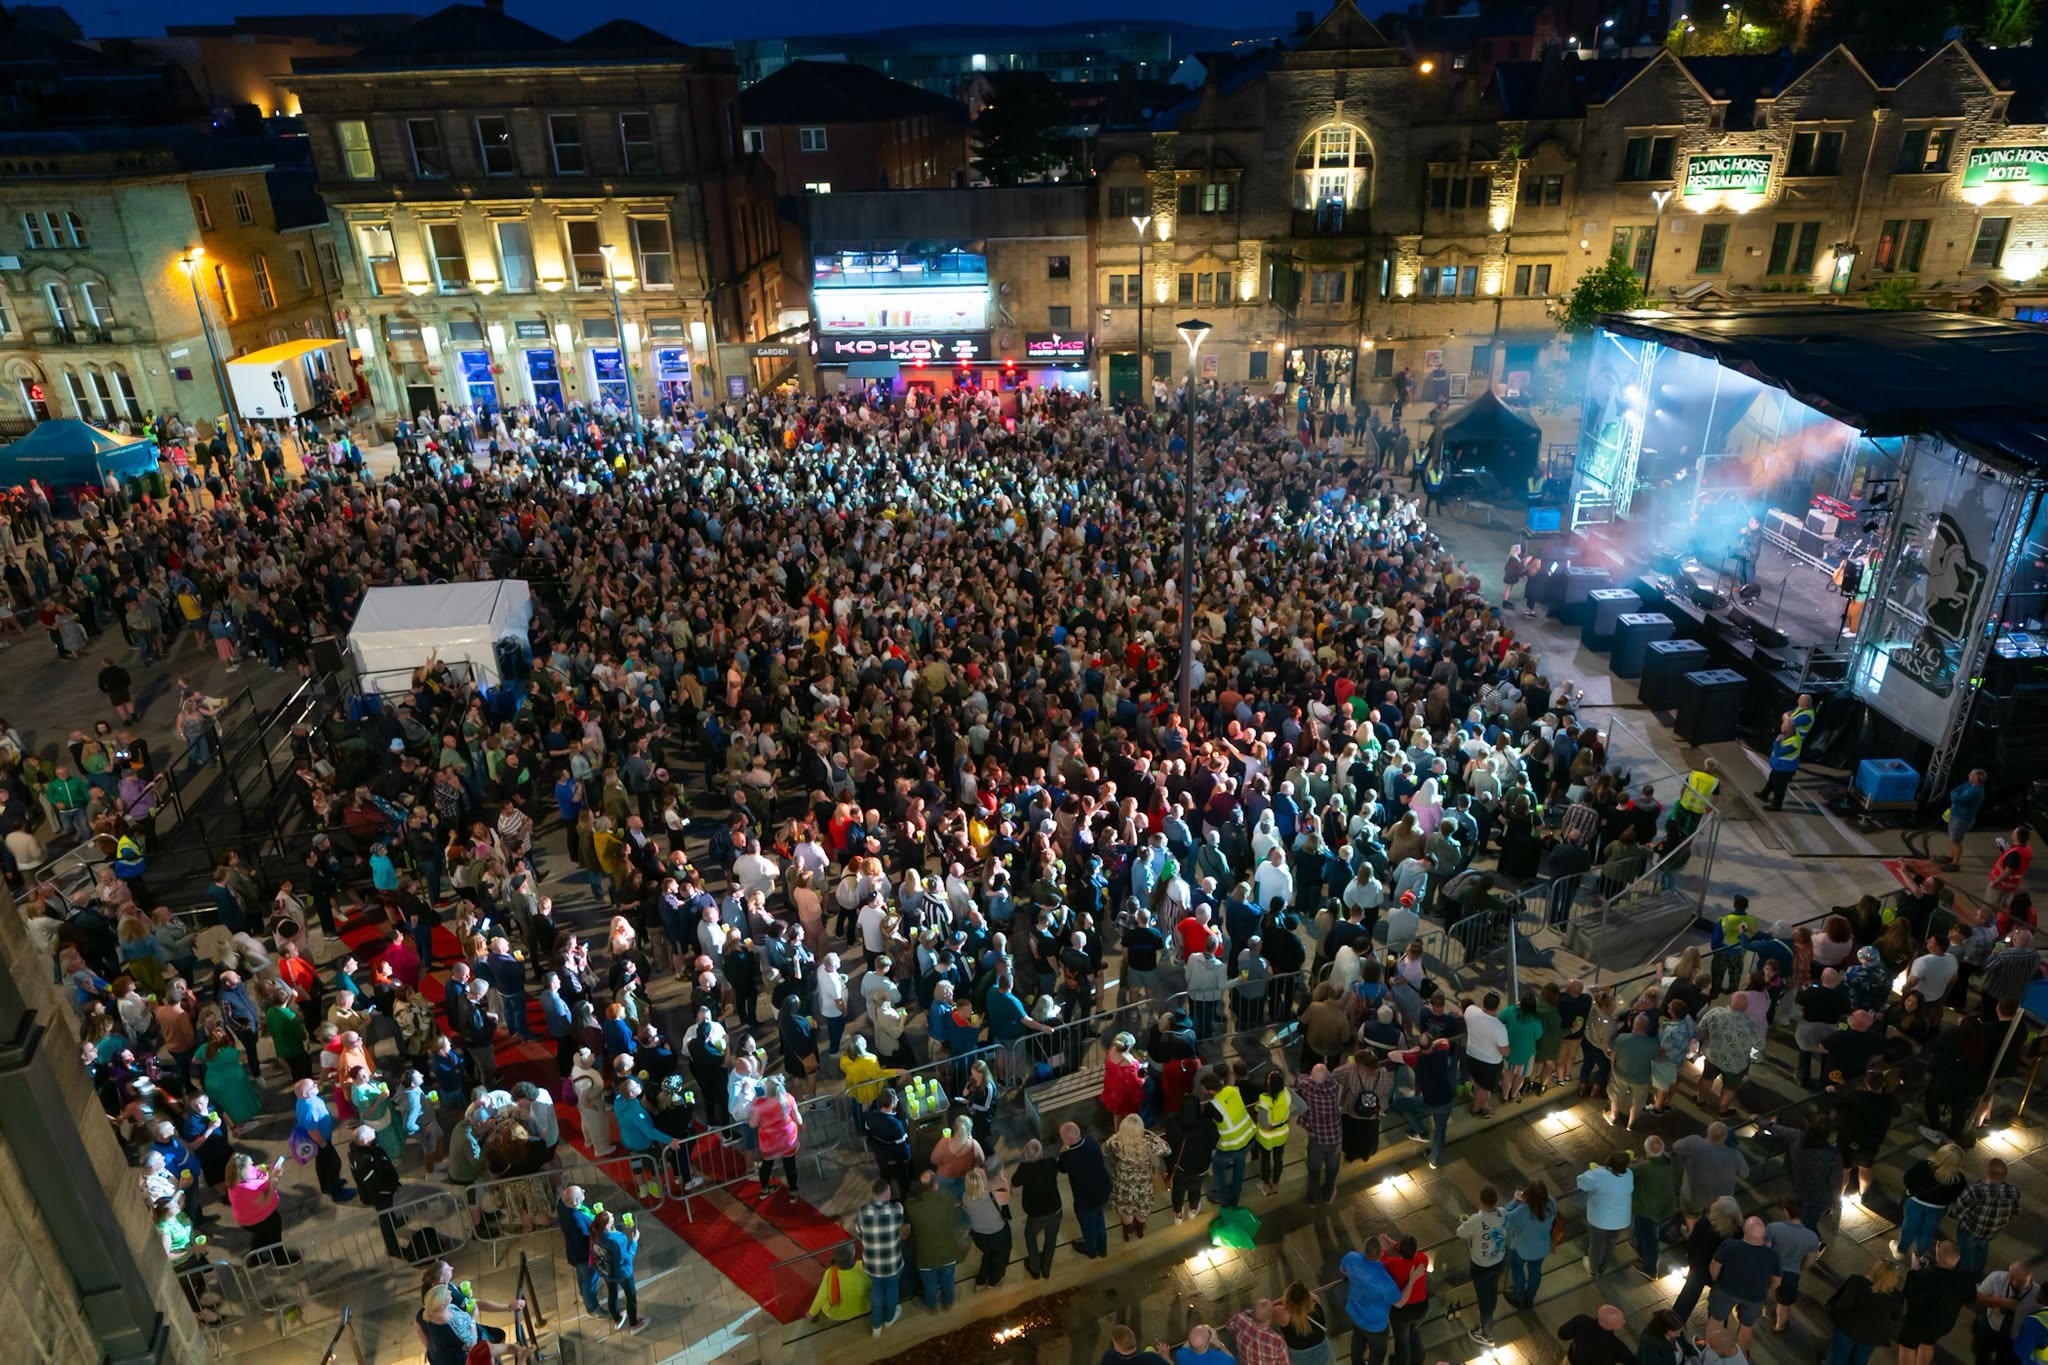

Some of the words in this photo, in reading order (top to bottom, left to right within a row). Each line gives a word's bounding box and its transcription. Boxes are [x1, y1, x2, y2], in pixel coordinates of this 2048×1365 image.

[1970, 150, 2015, 168] FLYING
[2014, 149, 2048, 165] HORS
[1688, 158, 1731, 175] FLYING
[1729, 158, 1771, 173] HORSE
[1986, 166, 2030, 180] HOTEL
[1687, 174, 1767, 187] RESTAURANT
[835, 340, 931, 354] KO-KO
